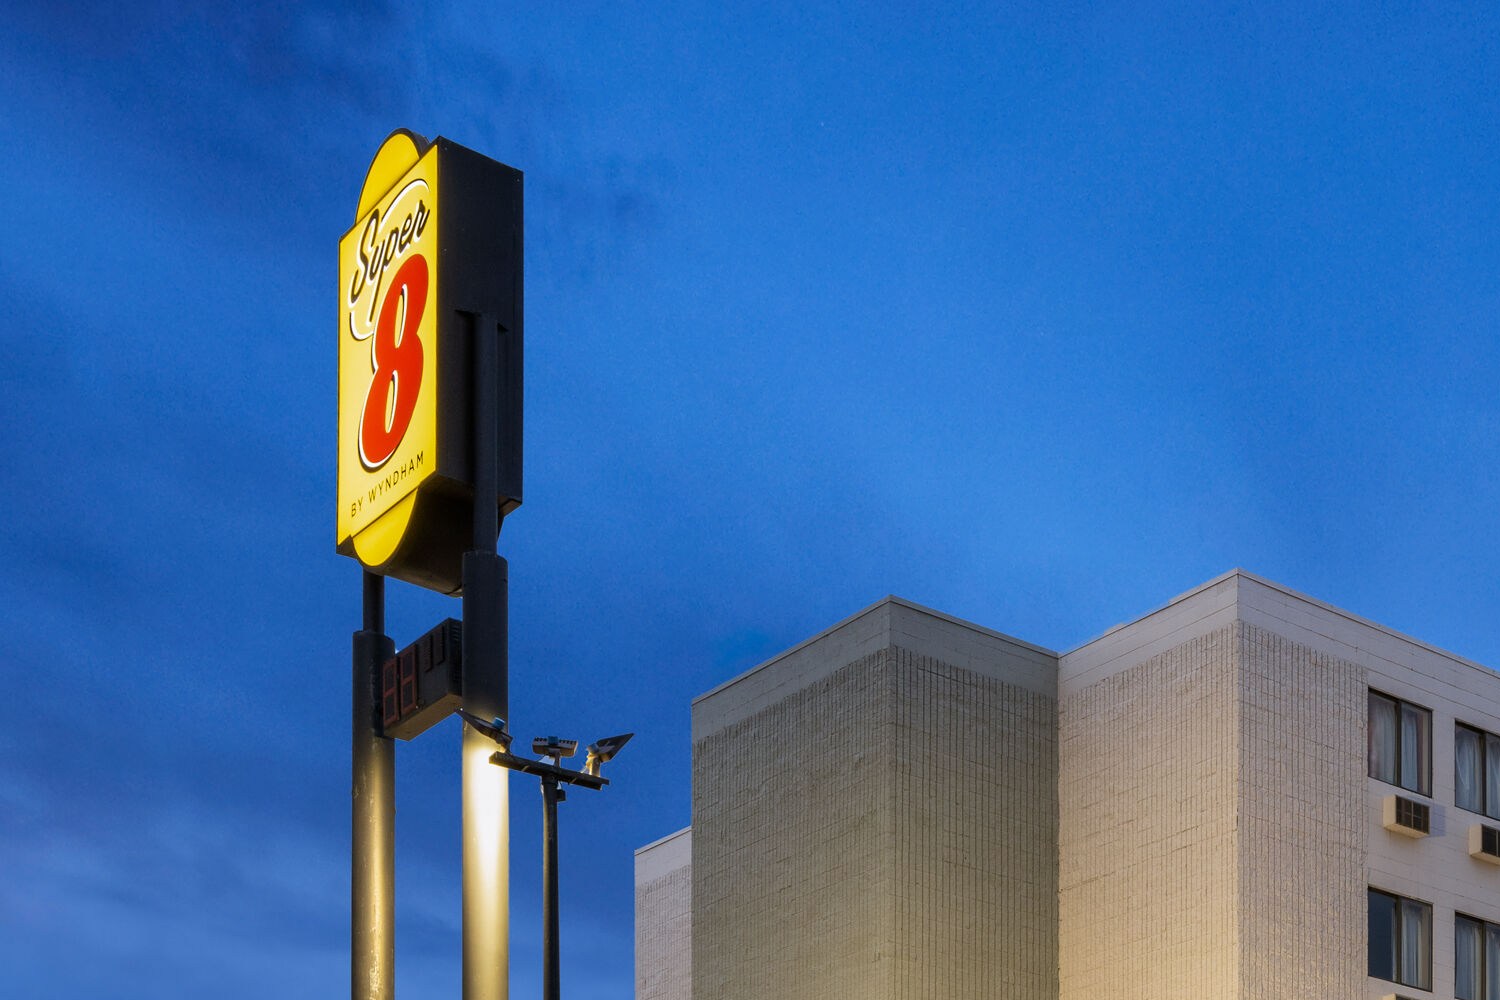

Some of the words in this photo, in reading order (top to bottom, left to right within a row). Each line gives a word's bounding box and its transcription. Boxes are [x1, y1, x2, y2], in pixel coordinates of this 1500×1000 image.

[350, 196, 430, 327] Super
[358, 253, 429, 474] 8
[351, 496, 363, 518] BY
[368, 450, 424, 504] WYNDHAM
